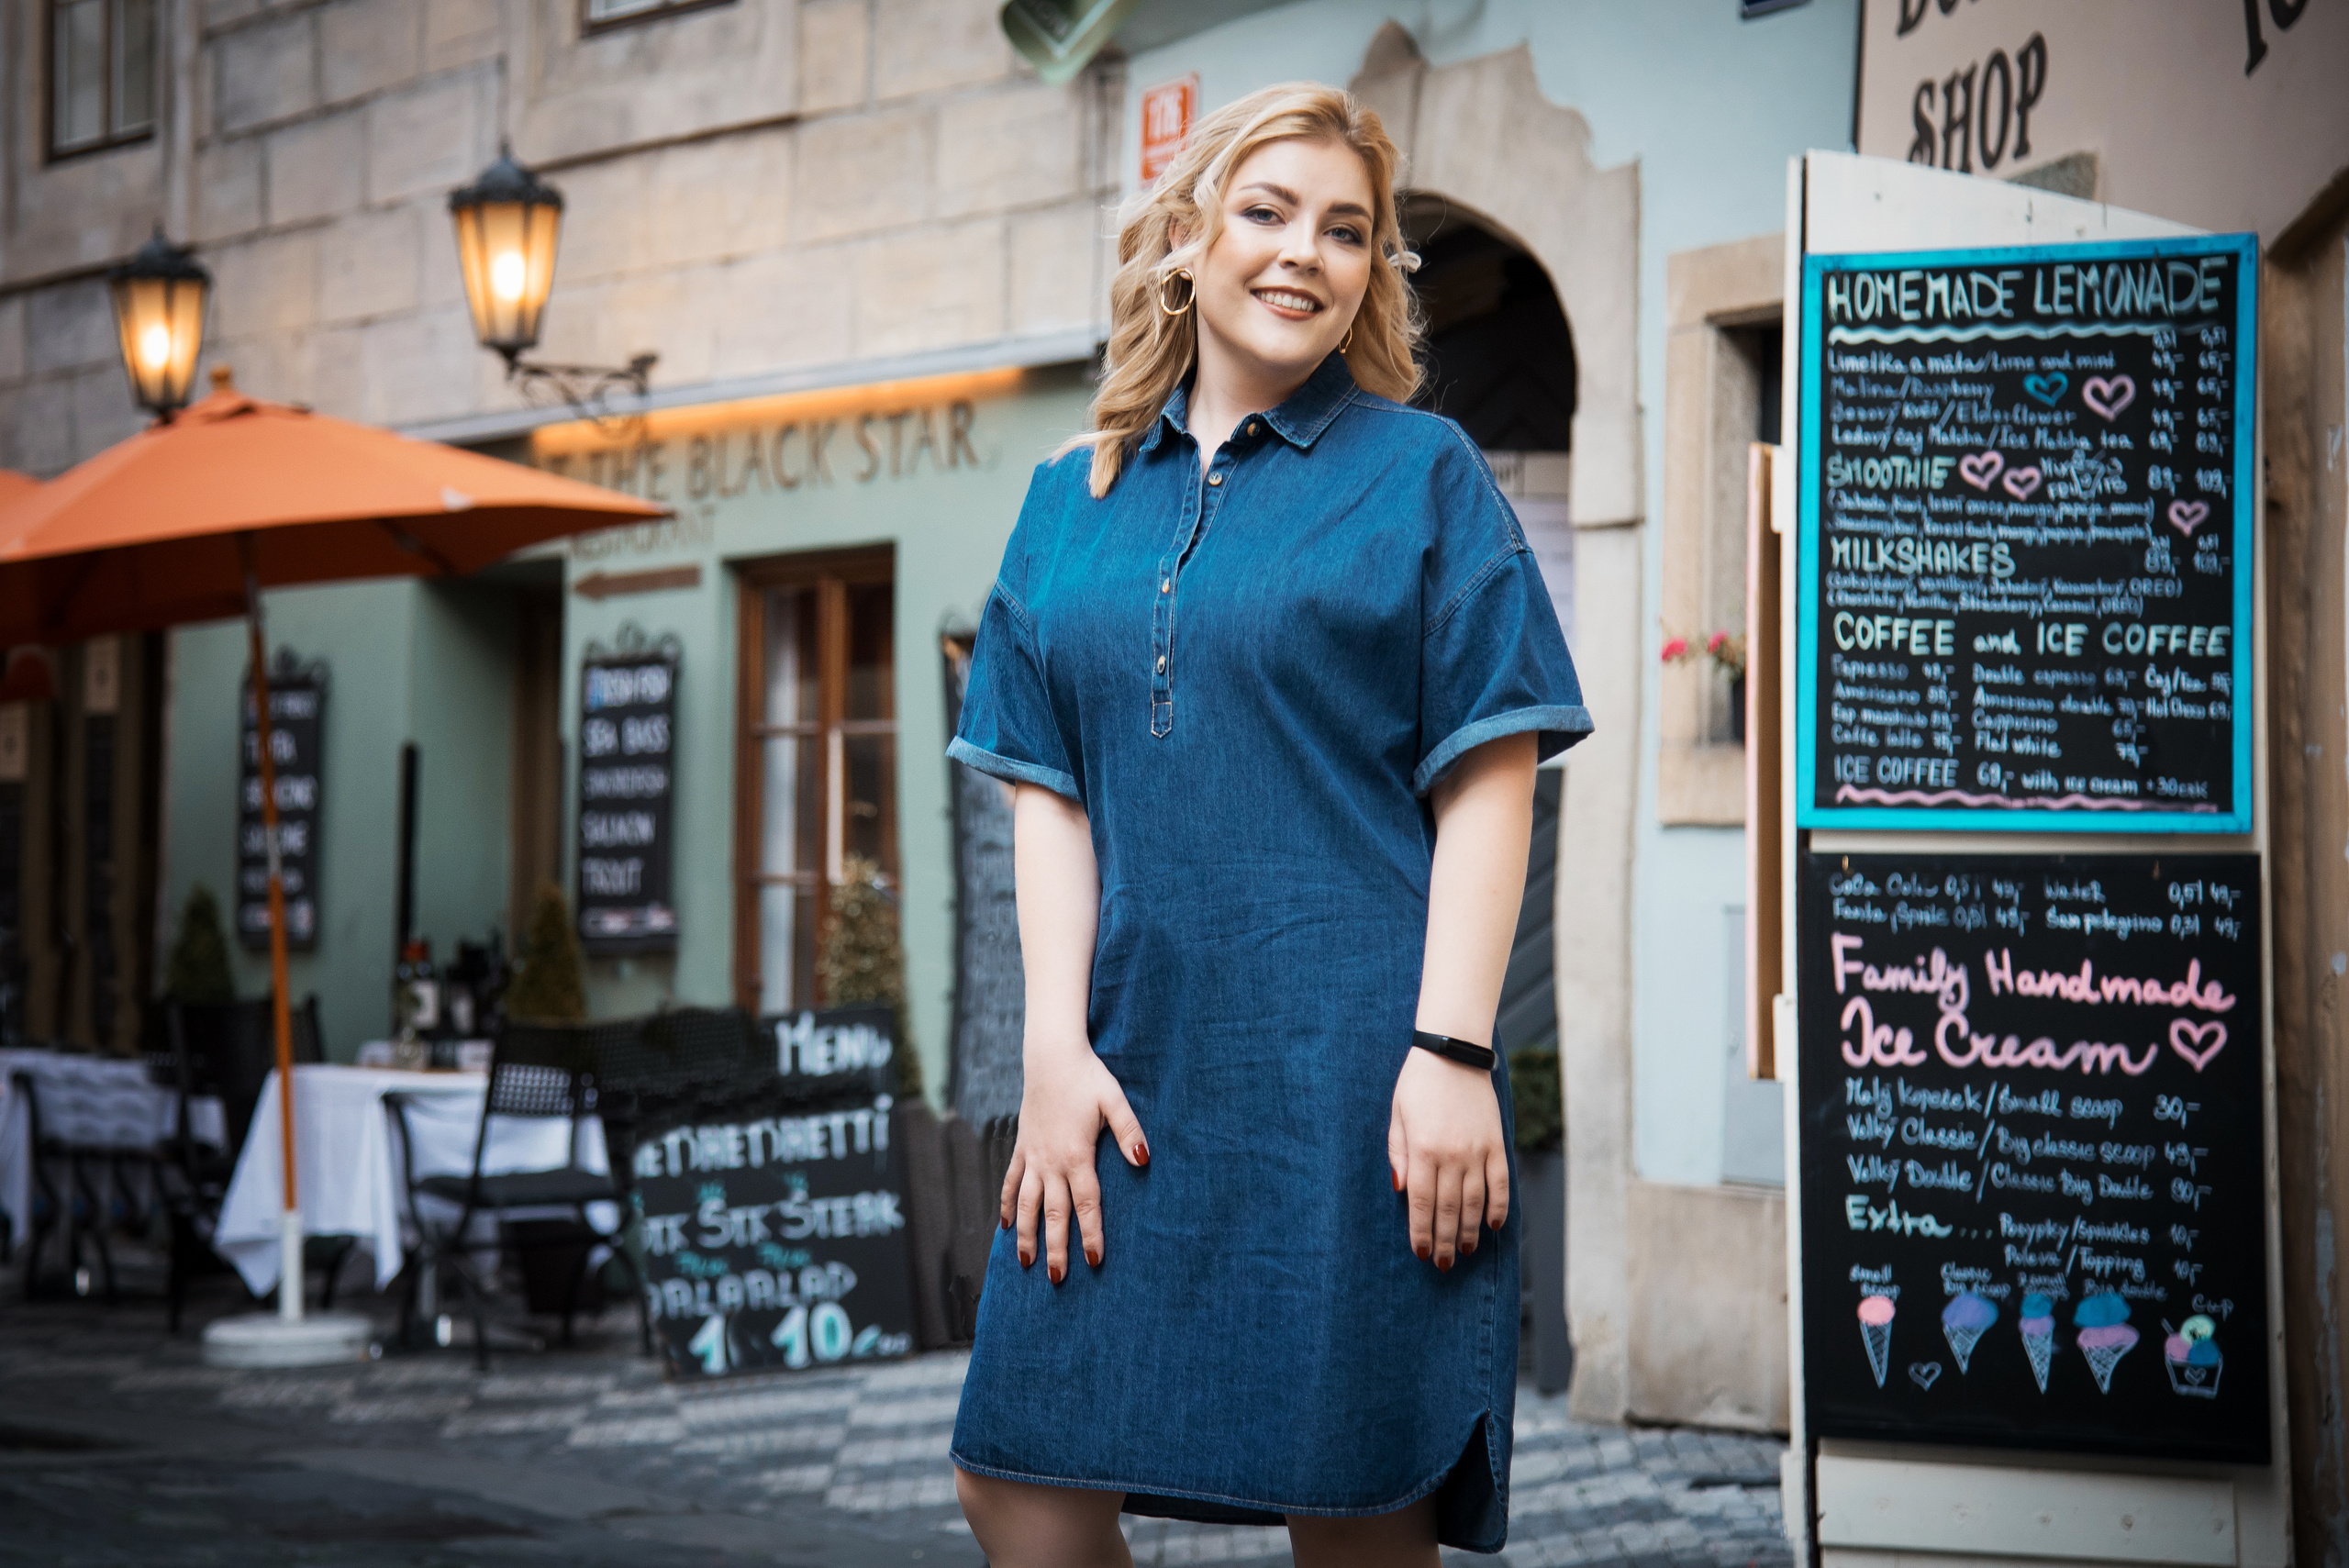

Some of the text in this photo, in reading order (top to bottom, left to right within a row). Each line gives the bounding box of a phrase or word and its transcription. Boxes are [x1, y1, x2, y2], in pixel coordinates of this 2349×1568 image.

[1908, 31, 2049, 173] SHOP
[1827, 255, 2229, 321] HOMEMADE LEMONADE
[686, 417, 841, 503] BLACK
[853, 398, 981, 486] STAR
[1826, 452, 1956, 490] SMOOTHIE
[1829, 537, 2016, 578] MILKSHAKES
[1833, 611, 2232, 657] COFFEE and ICE COFFEE
[1833, 753, 1872, 784] ICE
[1876, 754, 1960, 787] COFFEE
[2021, 769, 2059, 794] with
[1831, 930, 2236, 1013] Family Handmade
[1840, 996, 2158, 1076] Ice Cream
[2069, 1095, 2123, 1129] scoop
[2099, 1140, 2155, 1171] scoop
[2079, 1245, 2145, 1283] Topping
[2191, 1293, 2234, 1322] Cup
